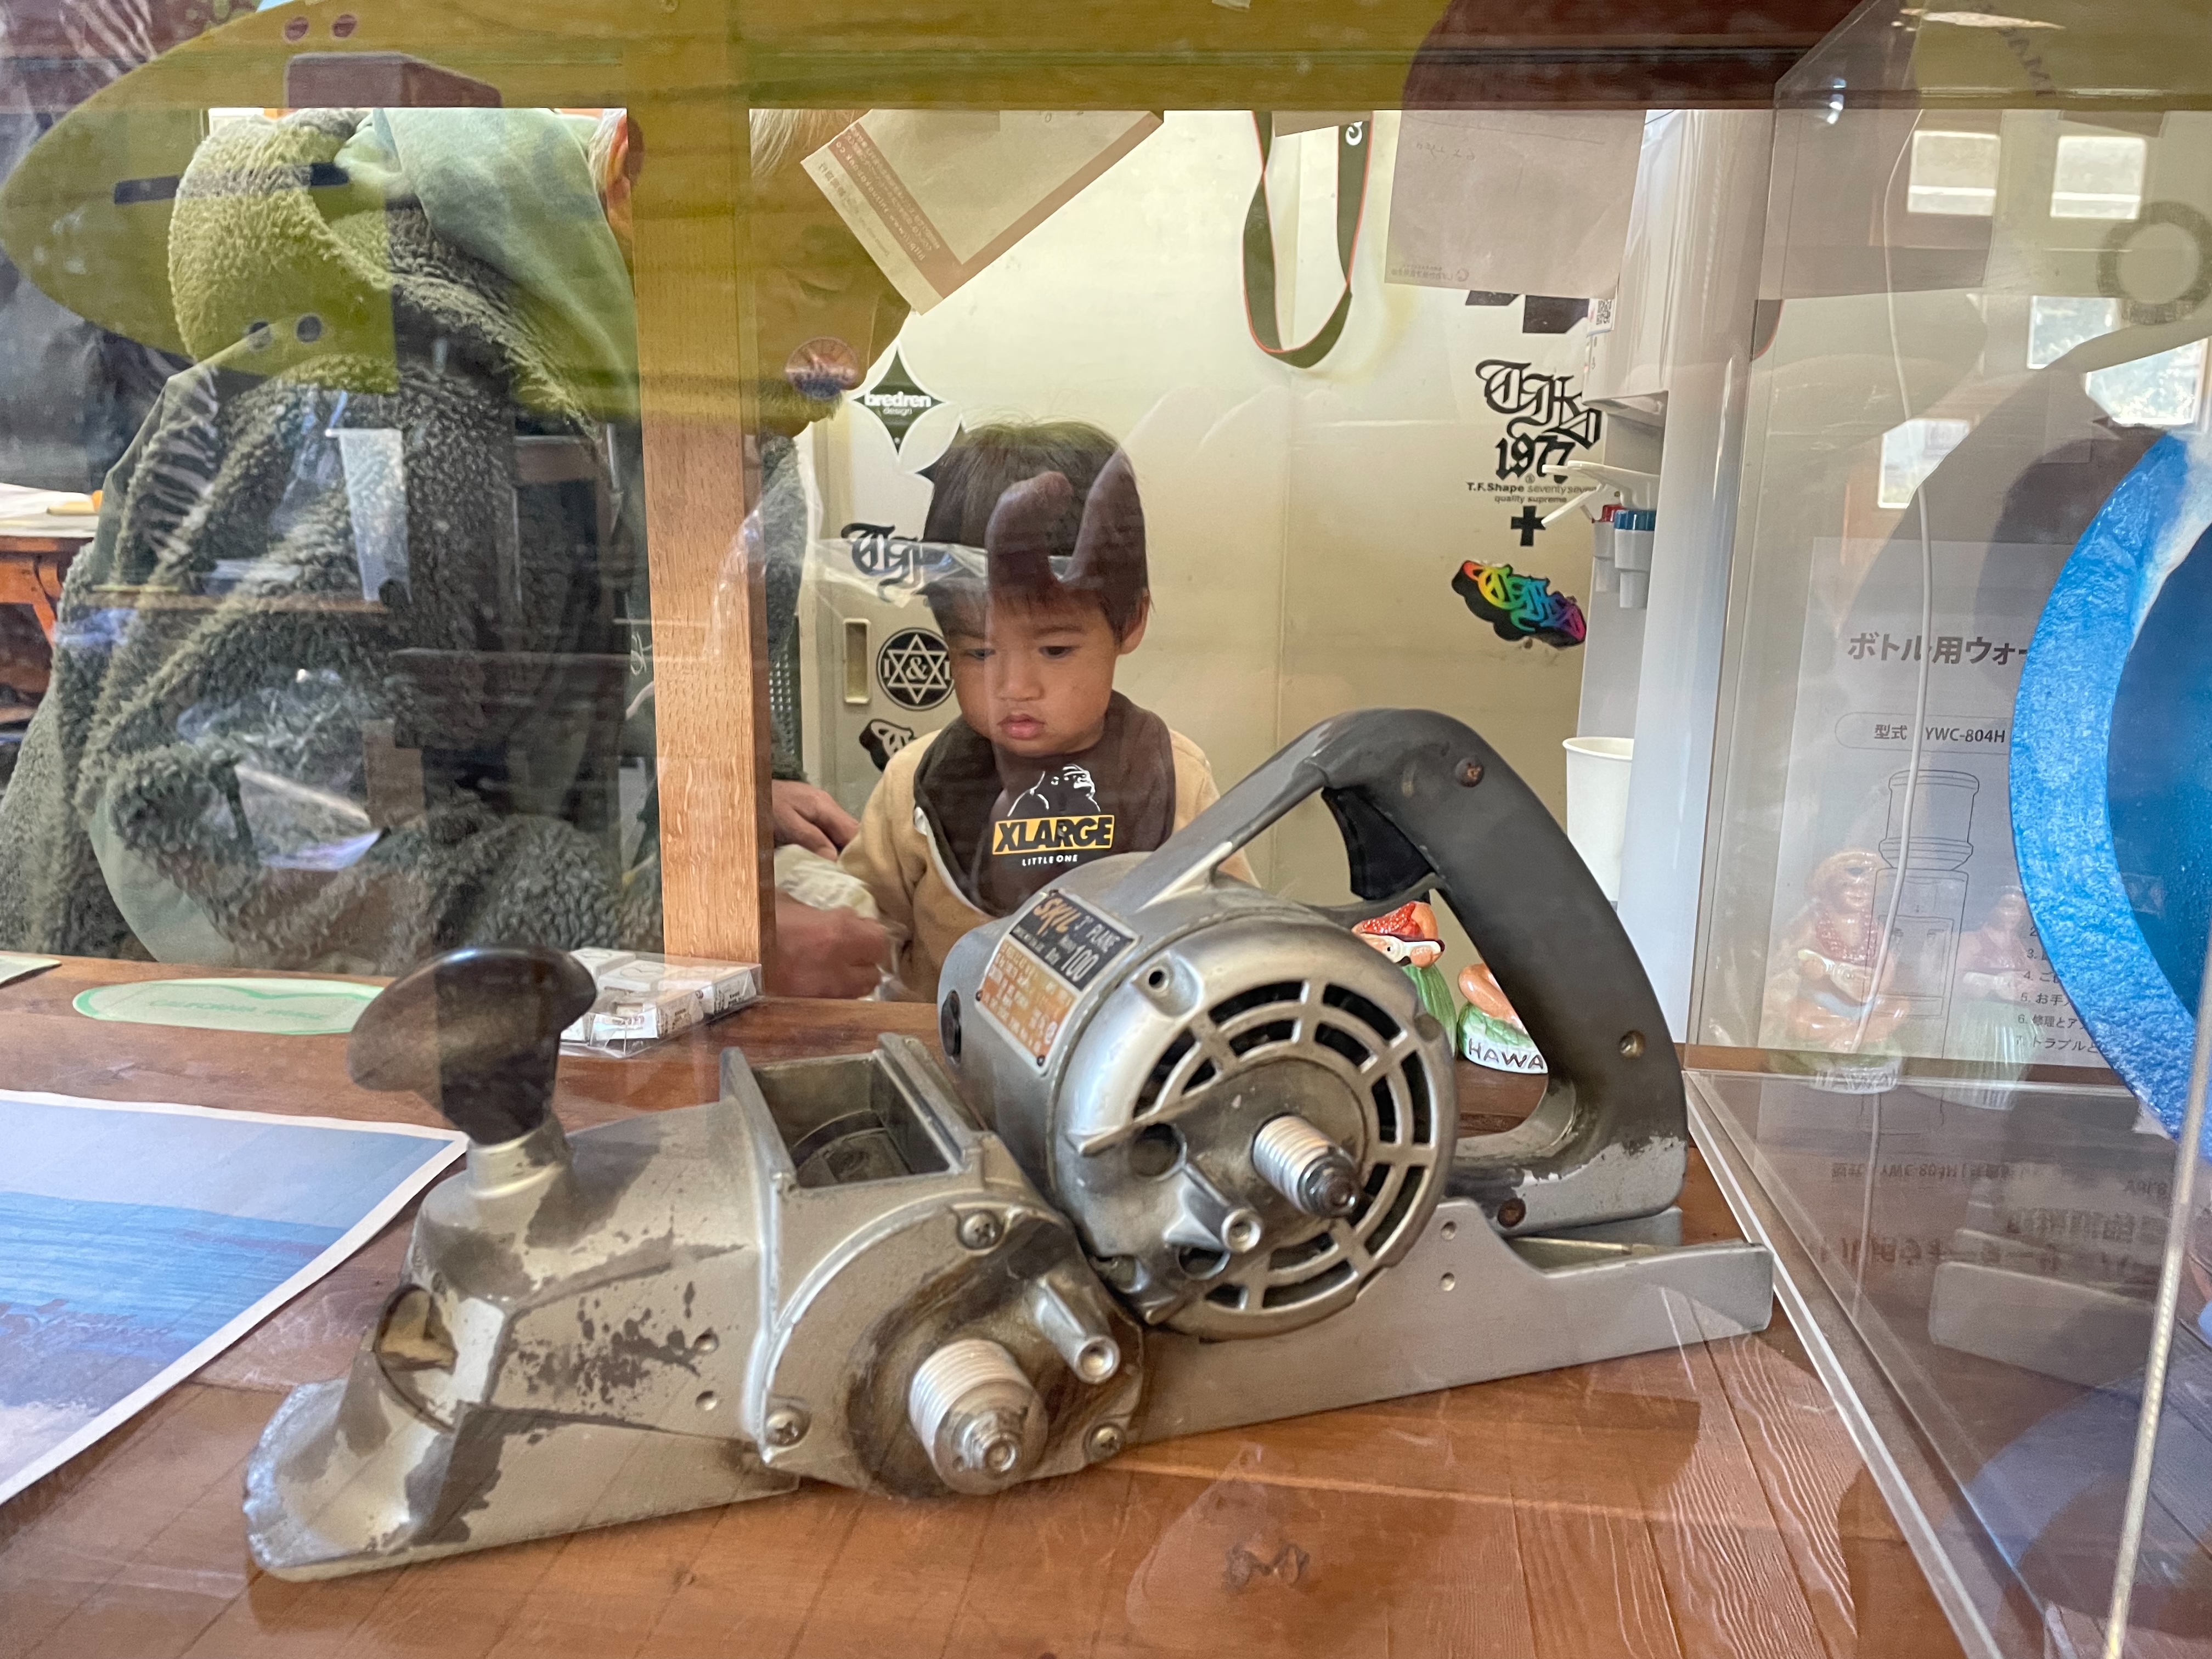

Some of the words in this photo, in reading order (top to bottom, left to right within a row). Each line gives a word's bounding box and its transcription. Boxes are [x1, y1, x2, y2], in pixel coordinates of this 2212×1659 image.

[864, 391, 931, 408] bredren
[883, 408, 913, 416] design
[1495, 432, 1576, 481] 1977
[1494, 495, 1525, 504] quality
[906, 657, 928, 680] &
[1874, 724, 1908, 740] 型式
[1925, 727, 2005, 743] YWC-804H
[995, 817, 1113, 852] XLARGE
[1022, 856, 1053, 866] LITTLE
[1056, 854, 1078, 864] ONE
[1034, 898, 1081, 934] SKIL
[1060, 945, 1099, 981] 100
[2033, 1014, 2084, 1029] 修理とア
[1469, 1038, 1543, 1069] HAWA
